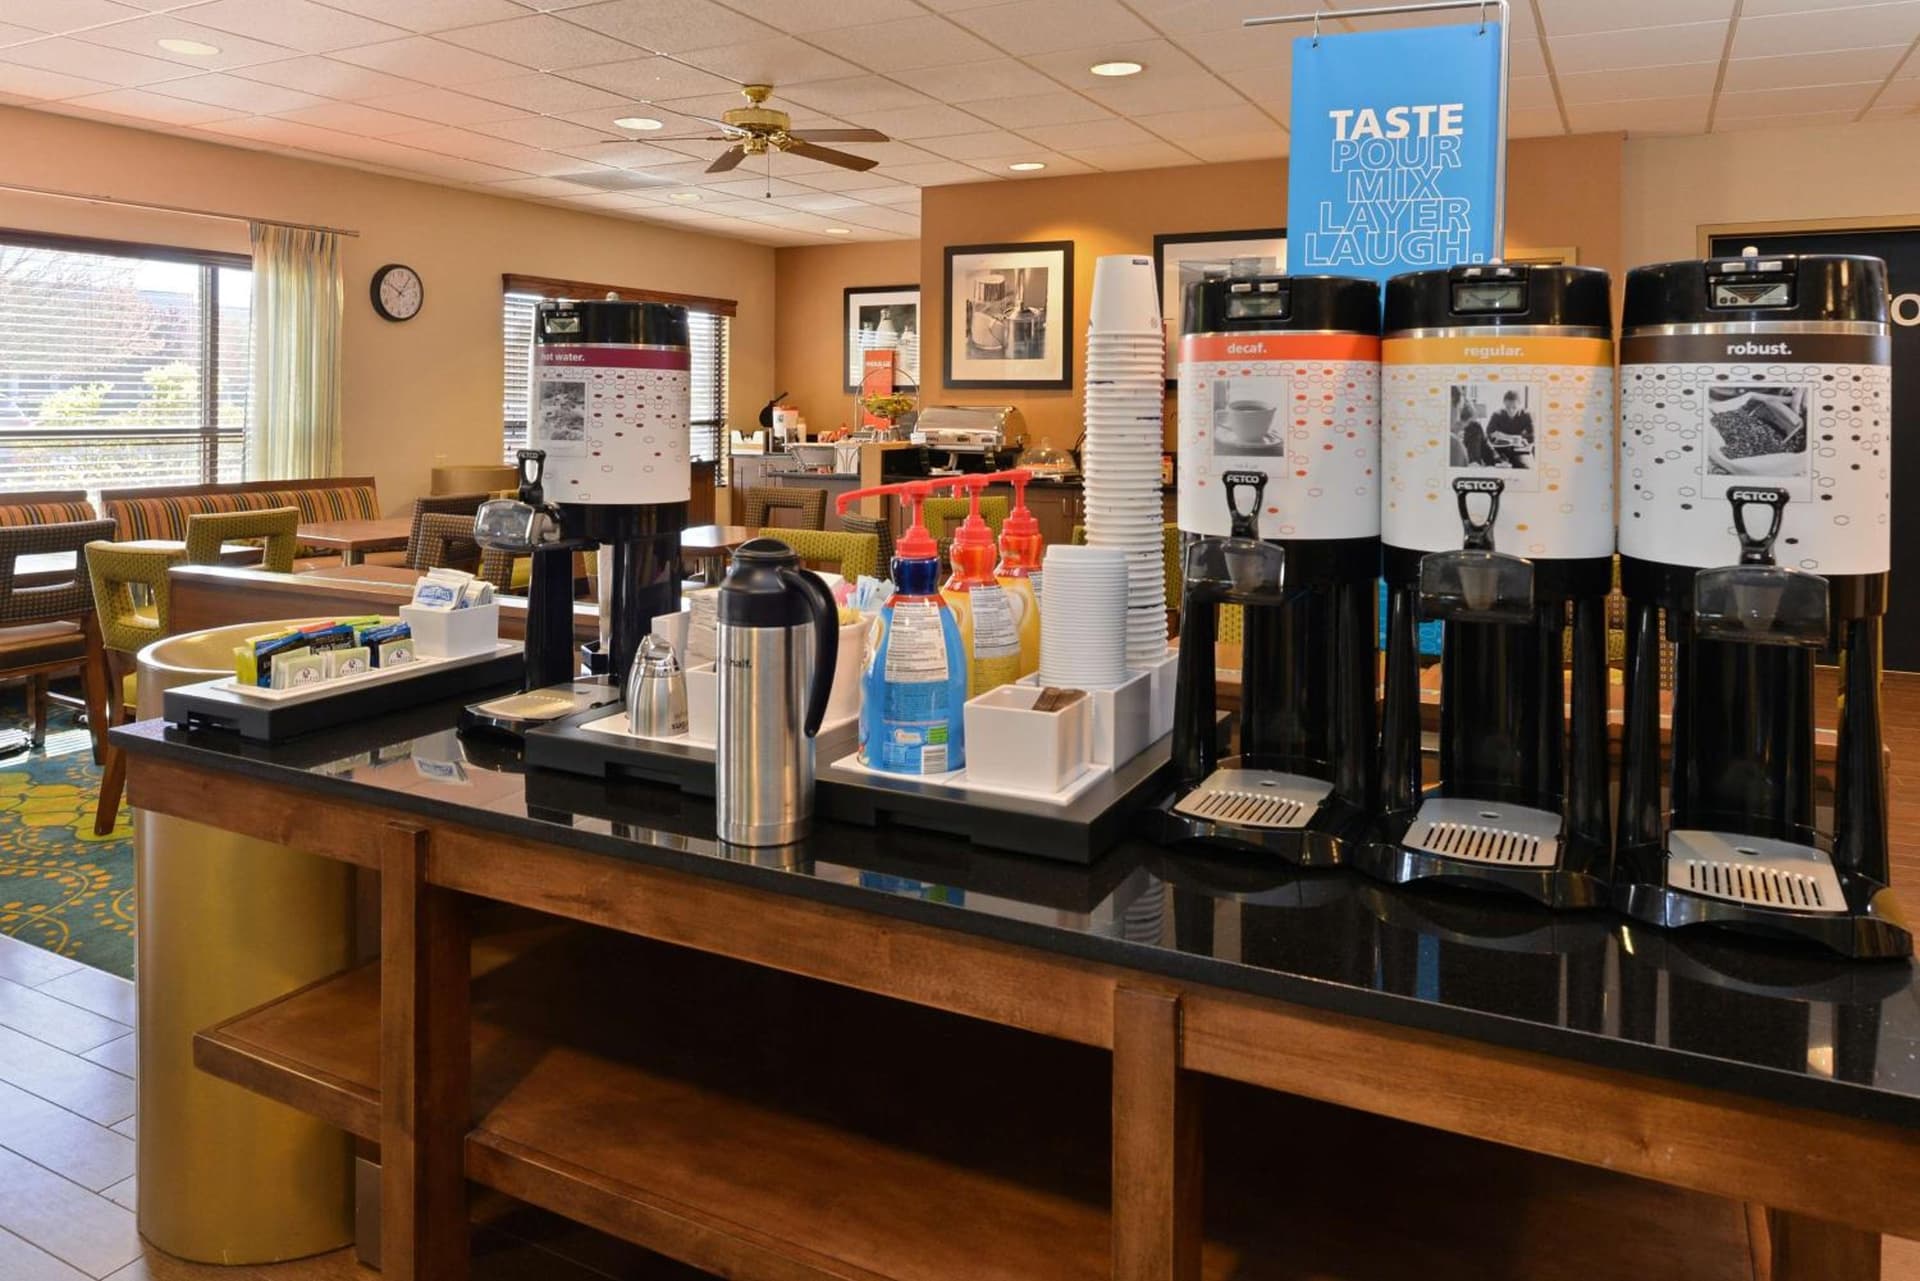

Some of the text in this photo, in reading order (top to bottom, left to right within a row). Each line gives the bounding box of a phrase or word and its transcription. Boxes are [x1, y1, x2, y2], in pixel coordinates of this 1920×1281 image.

[1329, 103, 1464, 141] TASTE
[1331, 134, 1462, 172] POUR
[1347, 166, 1443, 203] MIX
[1320, 198, 1471, 234] LAYER
[1305, 230, 1483, 266] LAUGH.
[1227, 342, 1267, 354] decaf.
[1464, 344, 1525, 360] regular.
[1727, 342, 1792, 355] robust.
[555, 352, 585, 362] water.
[1227, 474, 1260, 484] FETCO
[1457, 481, 1497, 490] FETCO
[1733, 491, 1778, 501] FETCO
